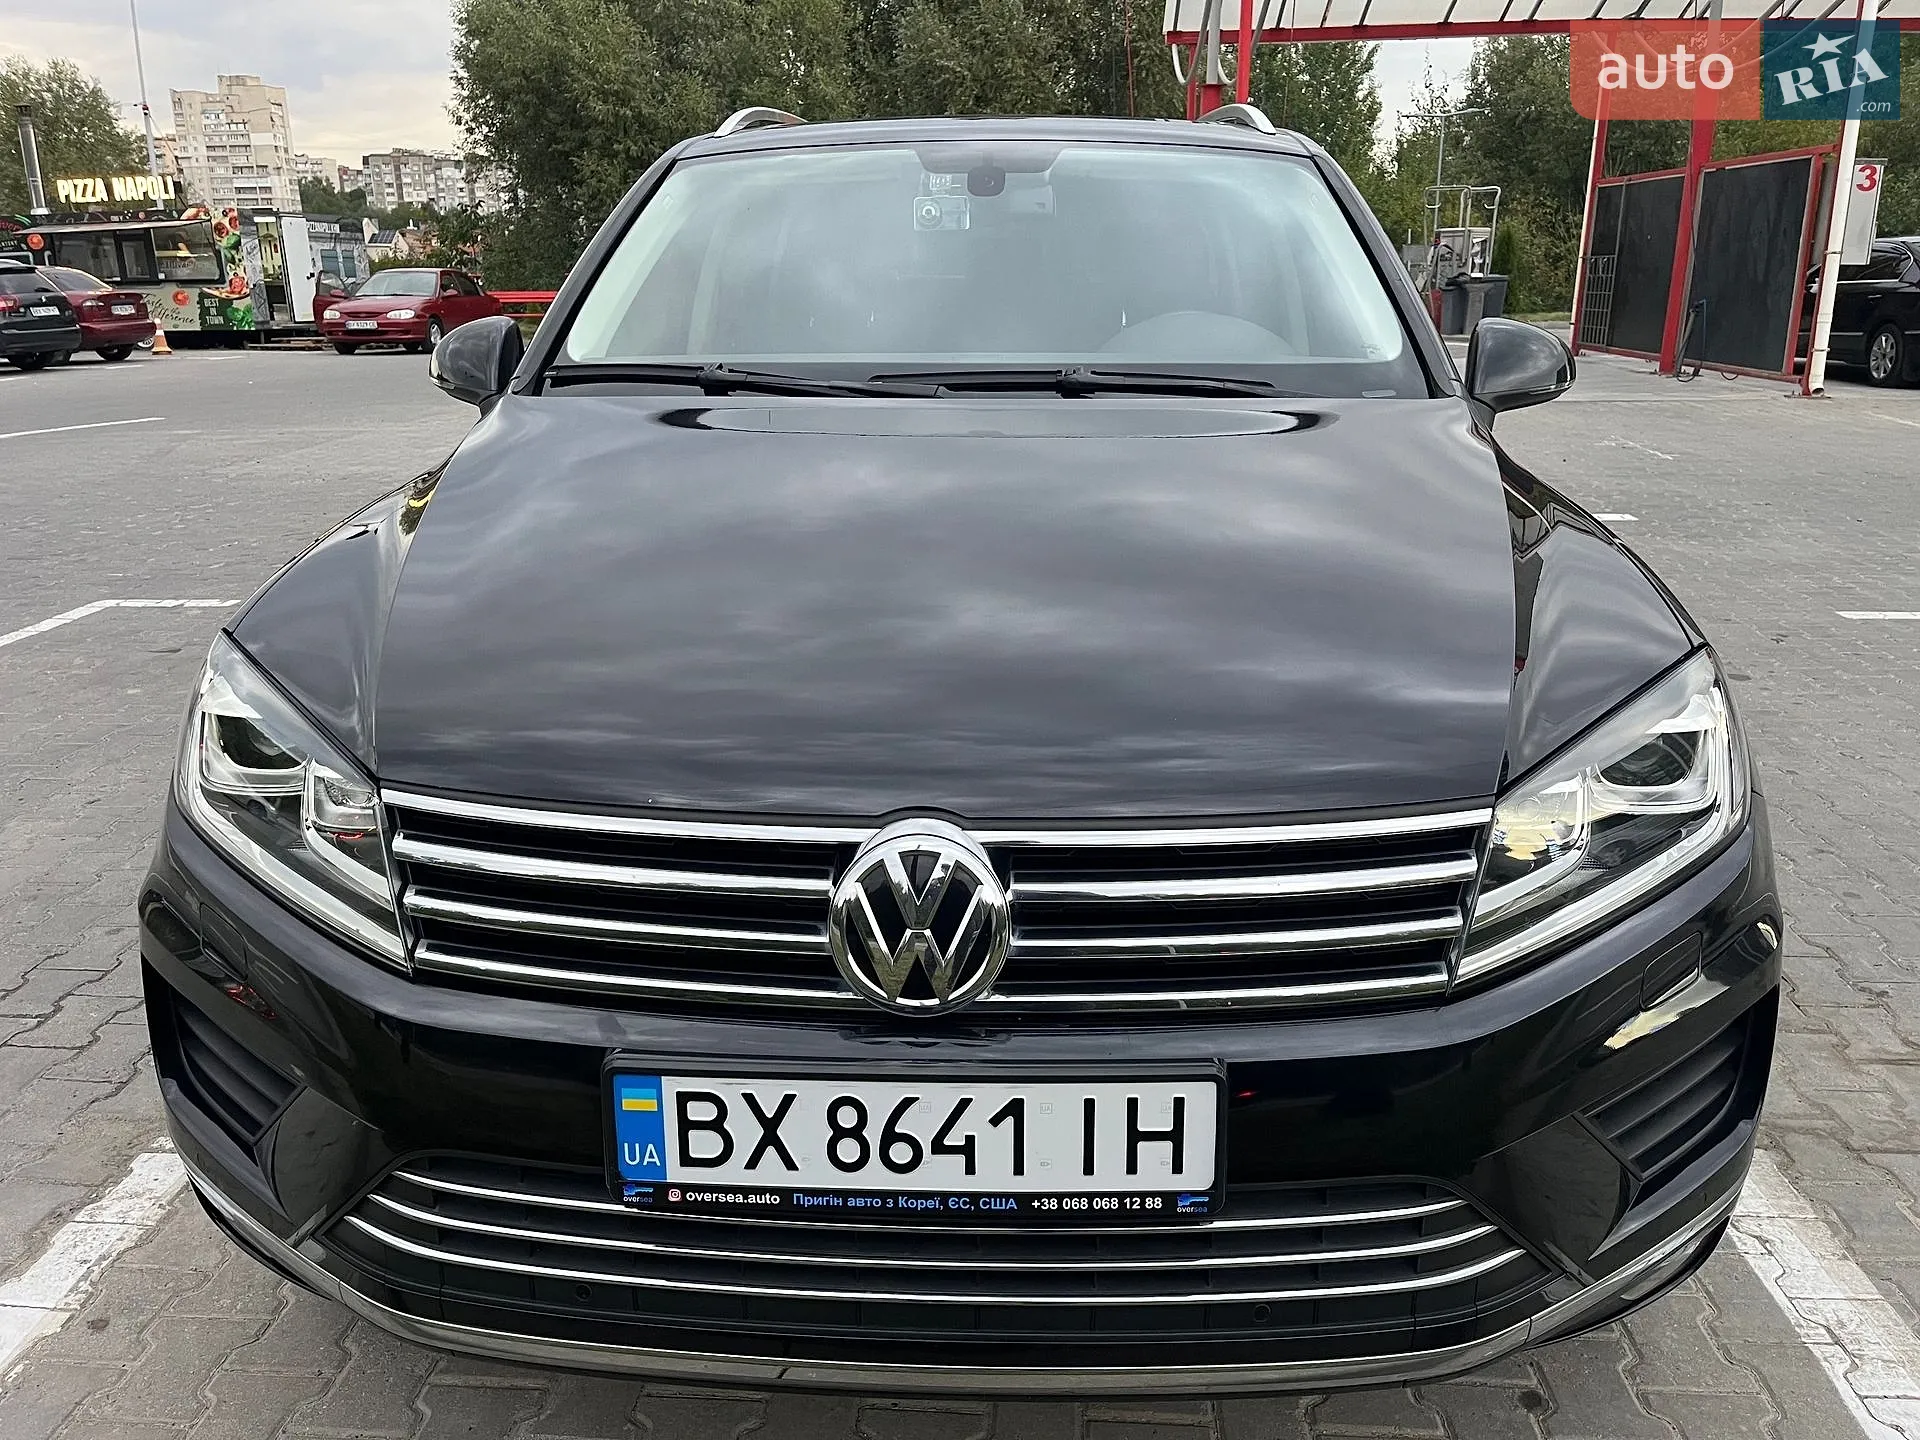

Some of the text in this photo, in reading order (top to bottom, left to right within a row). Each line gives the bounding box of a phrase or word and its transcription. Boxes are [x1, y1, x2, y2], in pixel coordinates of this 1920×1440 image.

[1855, 165, 1878, 192] 3
[56, 175, 176, 204] PIZZA NAPOLI
[203, 299, 219, 307] BEST
[675, 1090, 1186, 1176] BX 8641 IH
[623, 1142, 661, 1166] UA
[623, 1195, 653, 1204] oversea
[685, 1191, 781, 1205] oversea.auto
[793, 1192, 1018, 1211] Пригін авто з Кореї, ЄС, США
[1031, 1197, 1163, 1210] +38 068 068 12 88
